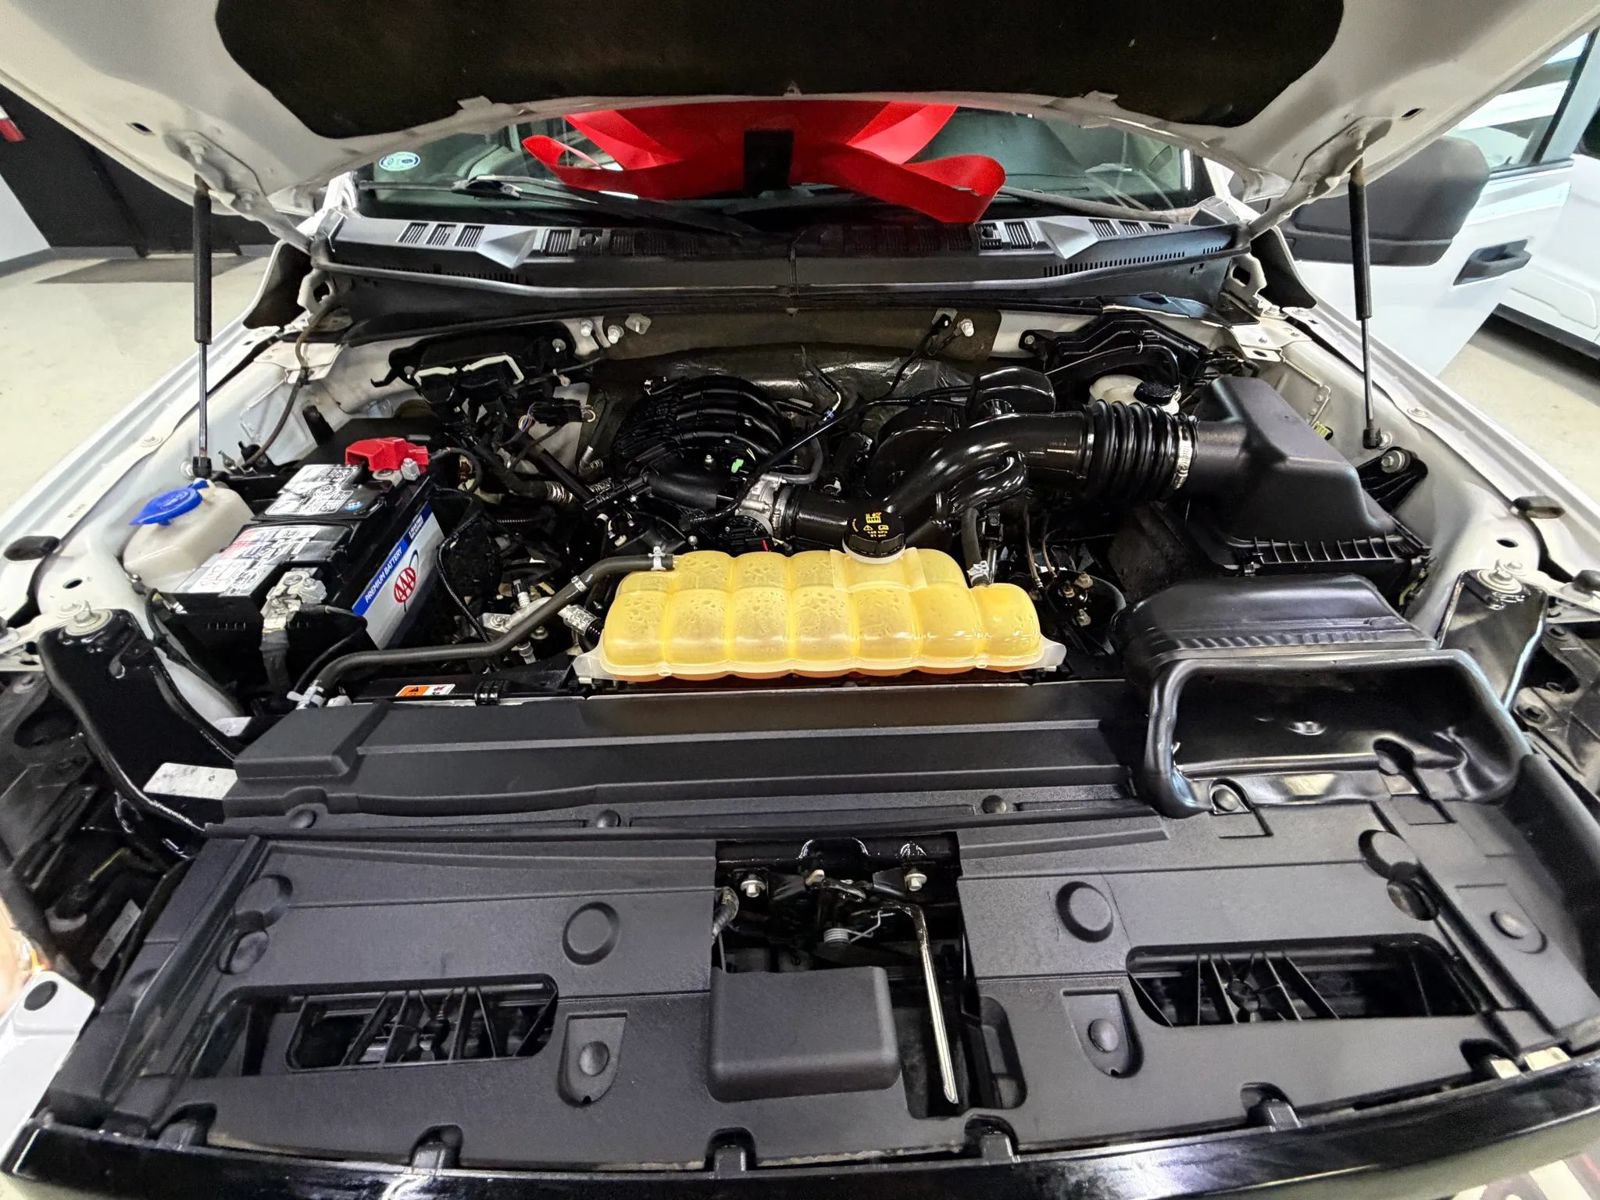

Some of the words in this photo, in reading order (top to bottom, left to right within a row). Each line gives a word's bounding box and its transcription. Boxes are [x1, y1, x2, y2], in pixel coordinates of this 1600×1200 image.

[364, 572, 386, 604] PREMIUM
[383, 546, 403, 575] BATTERY
[394, 567, 416, 603] AAA
